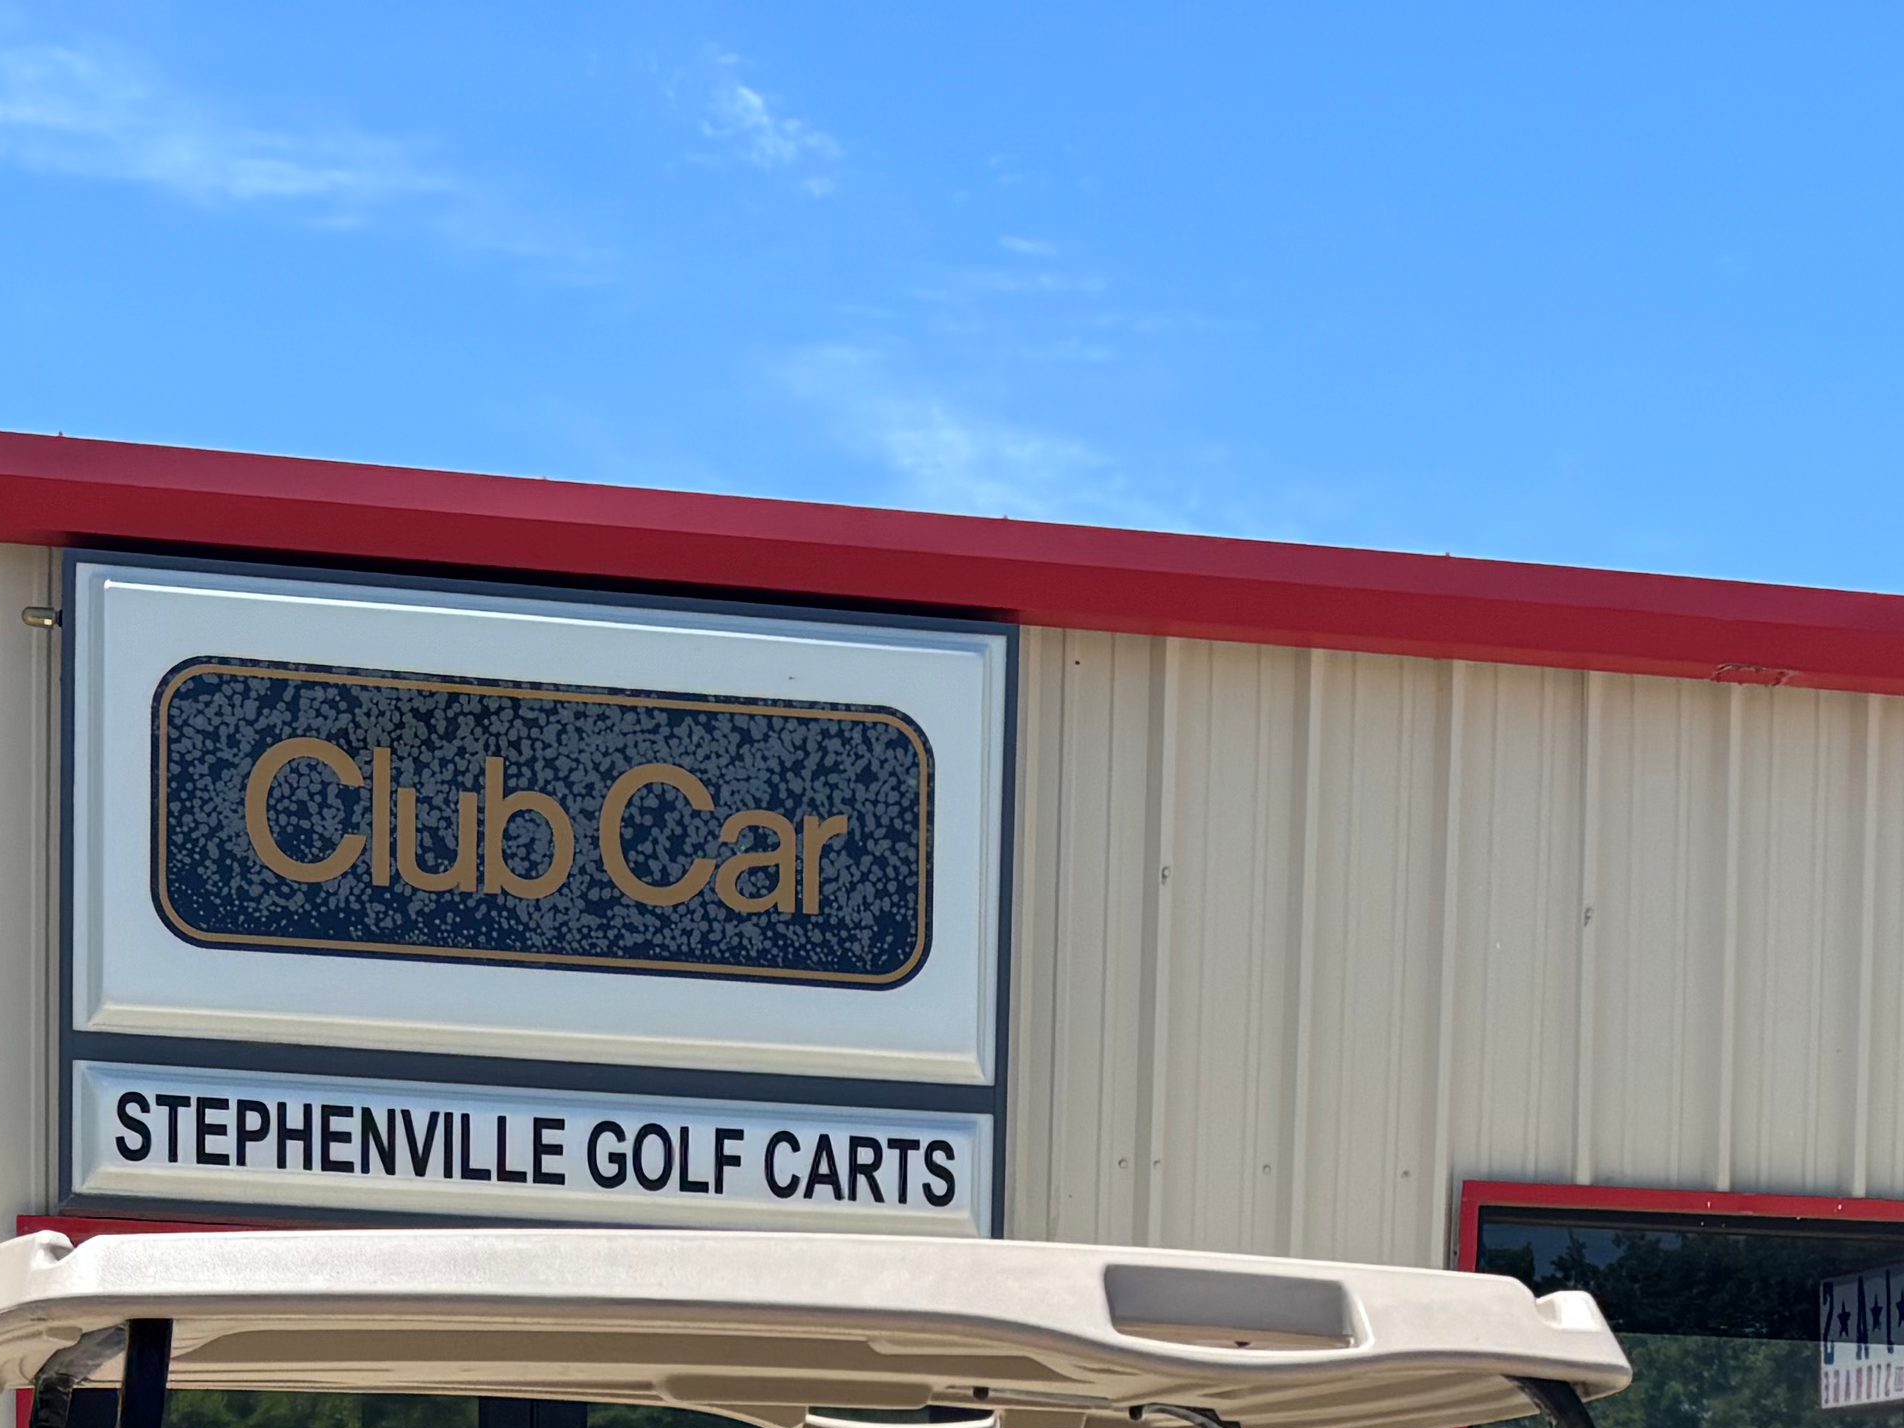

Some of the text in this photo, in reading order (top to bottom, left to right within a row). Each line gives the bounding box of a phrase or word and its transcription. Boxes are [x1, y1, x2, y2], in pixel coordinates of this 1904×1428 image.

[245, 737, 847, 915] Club Car
[115, 1090, 956, 1207] STEPHENVILLE GOLF CARTS
